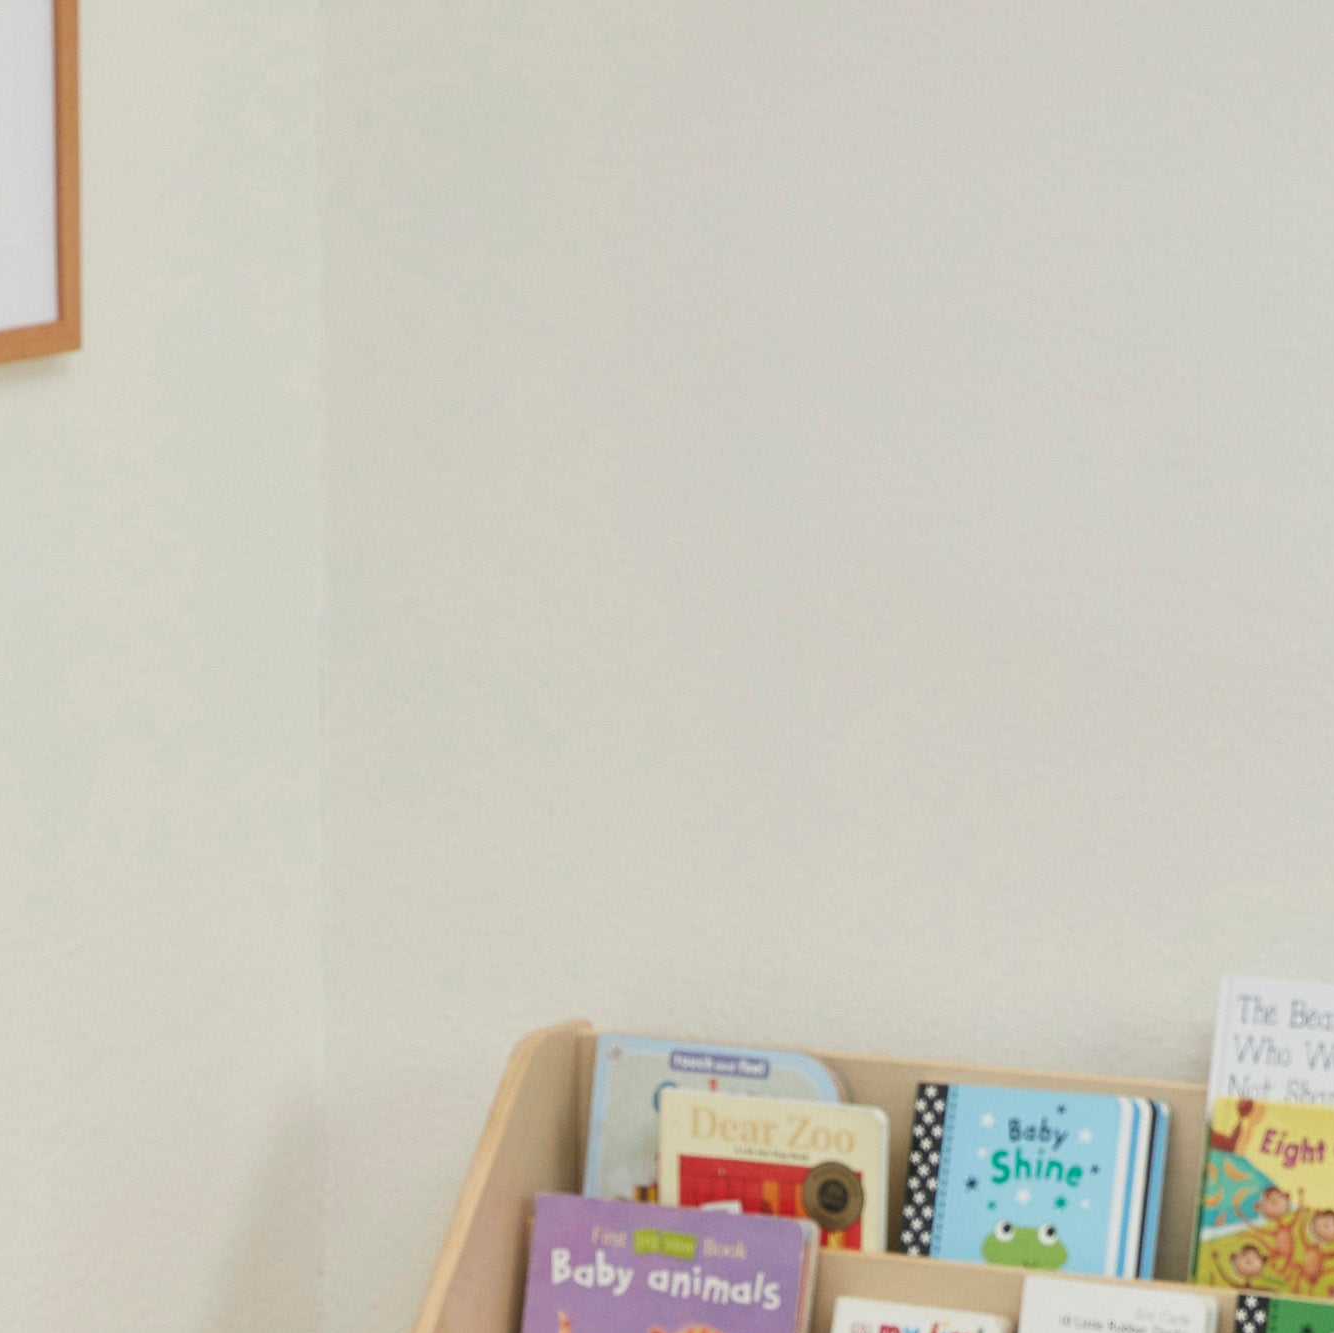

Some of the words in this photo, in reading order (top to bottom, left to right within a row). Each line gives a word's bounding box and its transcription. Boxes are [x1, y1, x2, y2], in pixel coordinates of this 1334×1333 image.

[1237, 993, 1279, 1026] The
[1233, 1034, 1292, 1068] Who
[690, 1104, 779, 1145] Dear
[787, 1115, 856, 1155] Zoo
[1008, 1116, 1069, 1152] Baby
[1259, 1127, 1326, 1169] Eight
[990, 1147, 1083, 1187] Shine
[551, 1247, 635, 1297] Baby
[646, 1264, 782, 1311] animals
